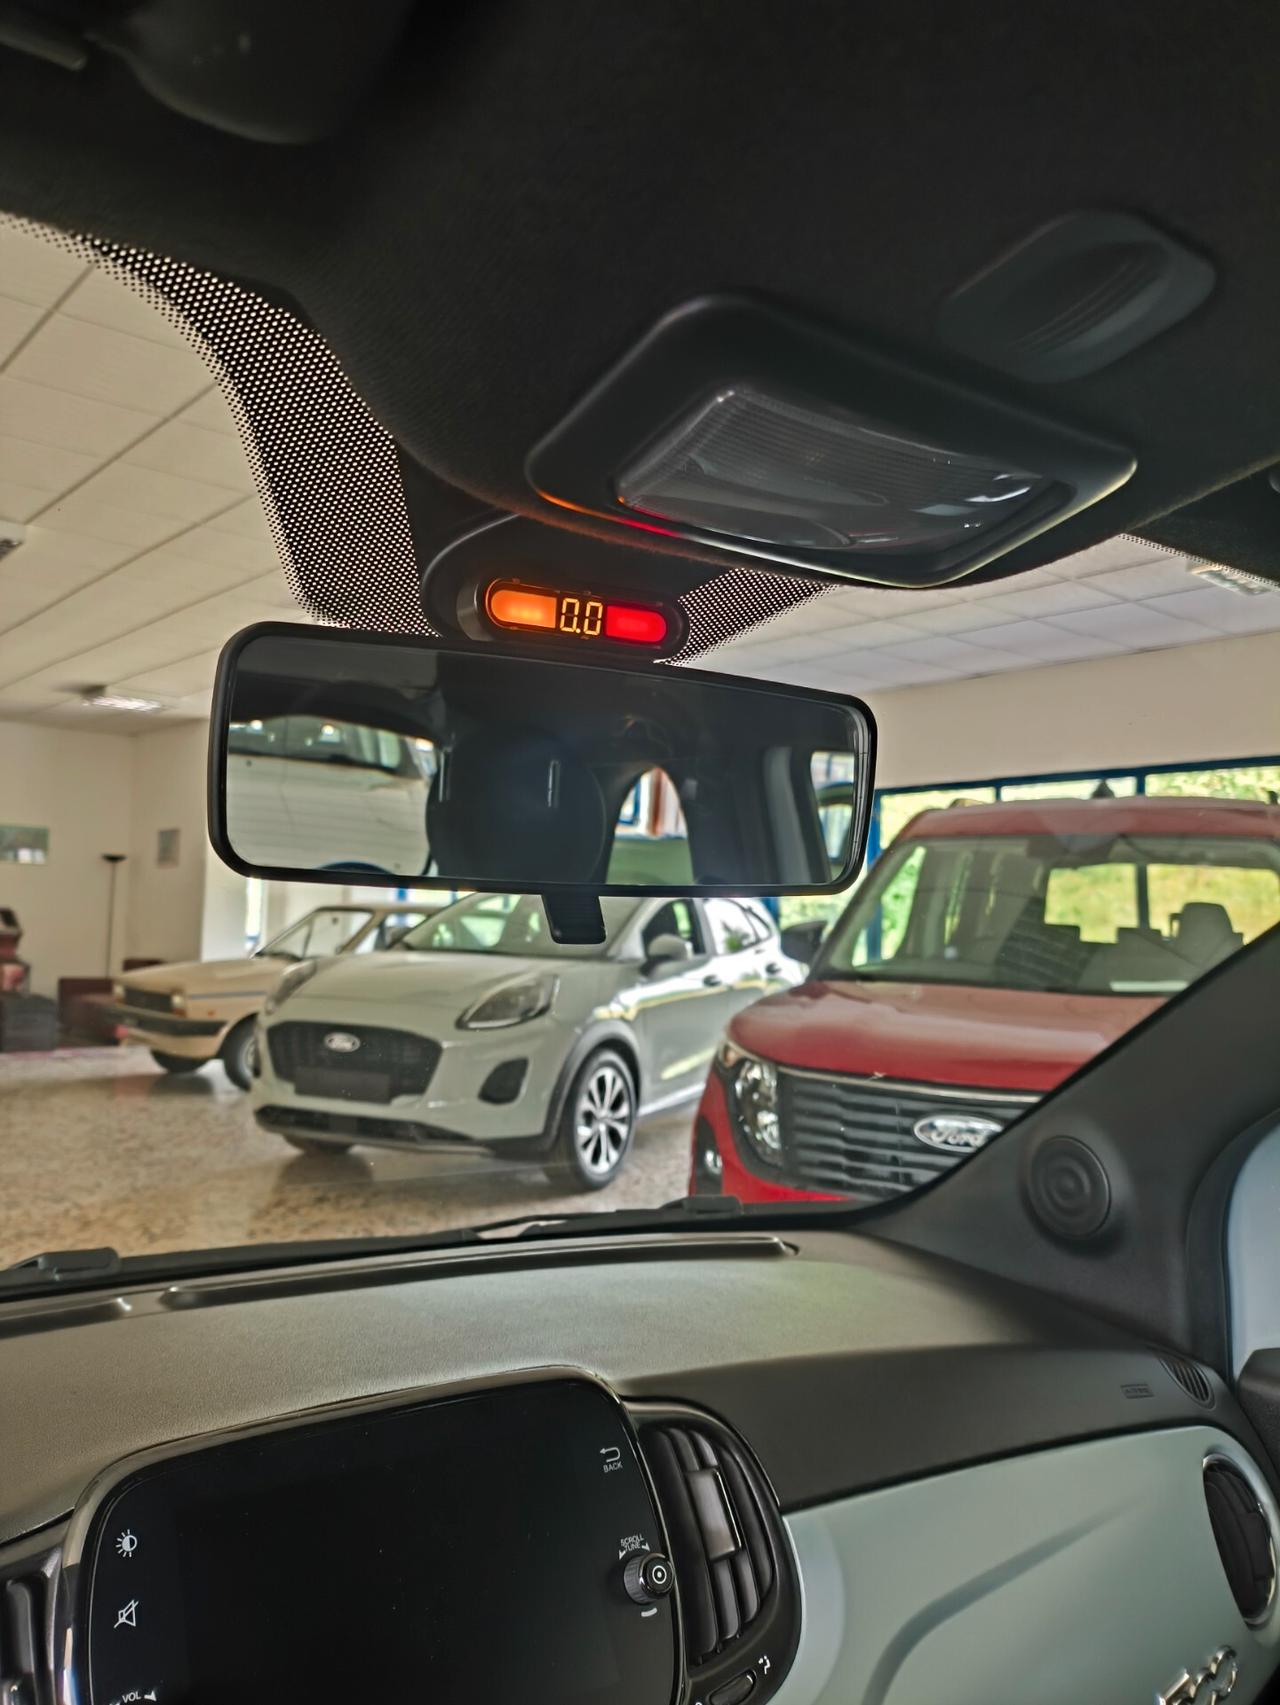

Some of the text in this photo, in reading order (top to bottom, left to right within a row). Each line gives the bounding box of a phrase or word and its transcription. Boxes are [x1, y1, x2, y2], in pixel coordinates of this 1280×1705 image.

[560, 598, 603, 636] 0.0
[603, 1461, 623, 1473] BACK
[620, 1533, 644, 1547] SCROLL
[122, 1691, 141, 1703] VOL
